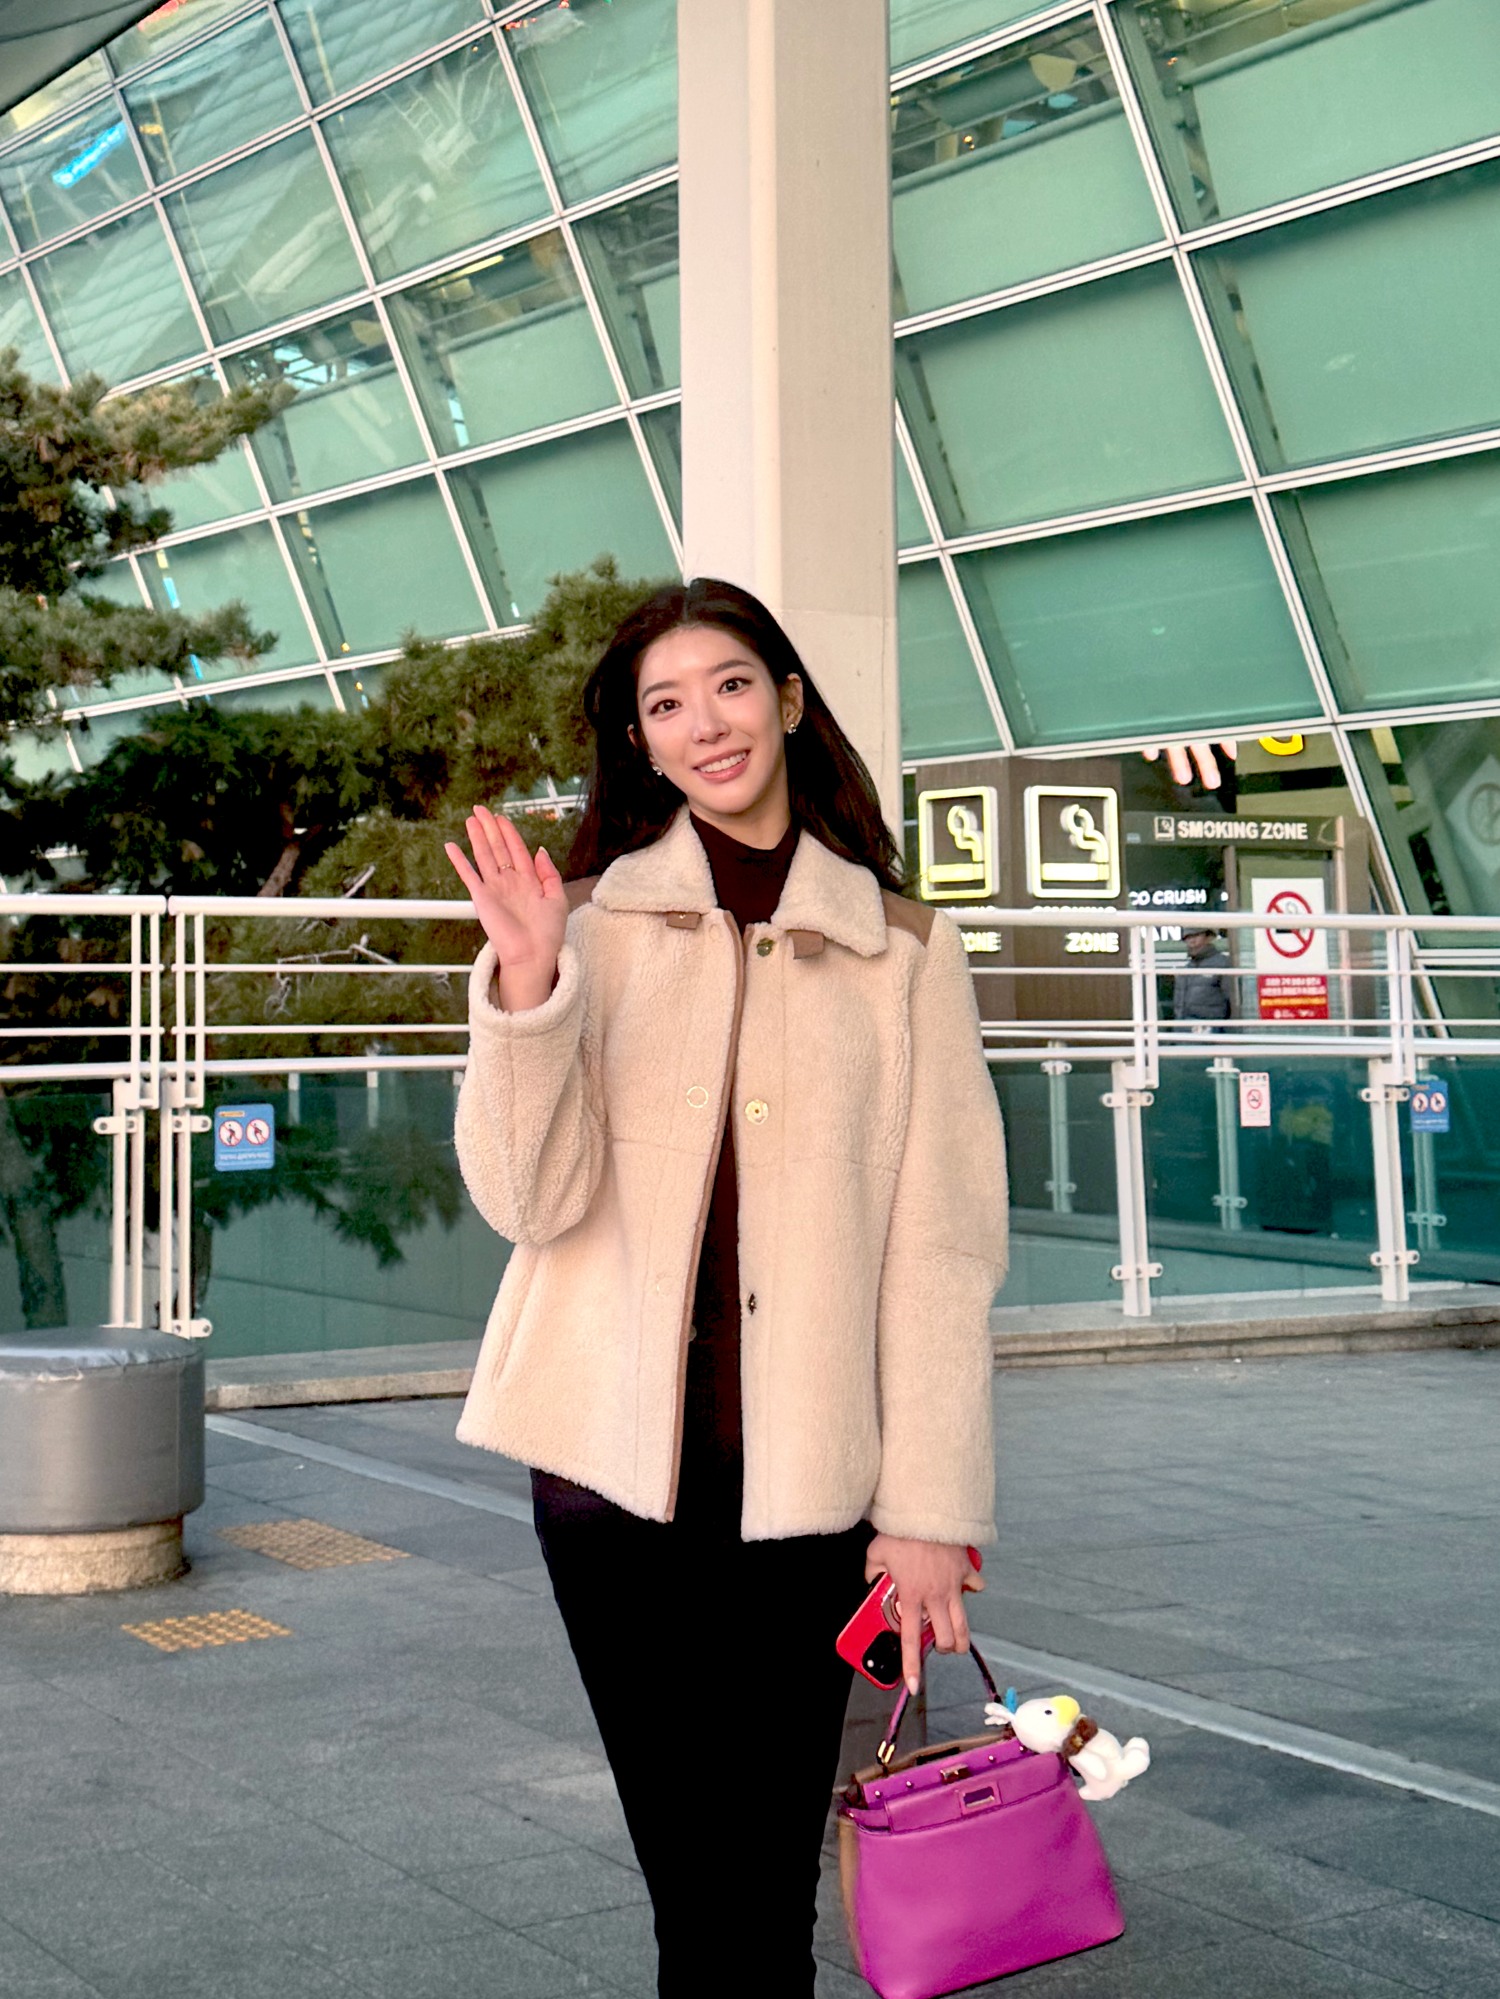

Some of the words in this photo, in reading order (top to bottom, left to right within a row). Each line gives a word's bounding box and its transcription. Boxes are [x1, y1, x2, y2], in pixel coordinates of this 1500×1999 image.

[1177, 820, 1258, 840] SMOKING
[1260, 822, 1308, 840] ZONE
[1152, 889, 1207, 905] CRUSH
[960, 931, 1001, 952] ONE
[1065, 931, 1120, 953] ZONE
